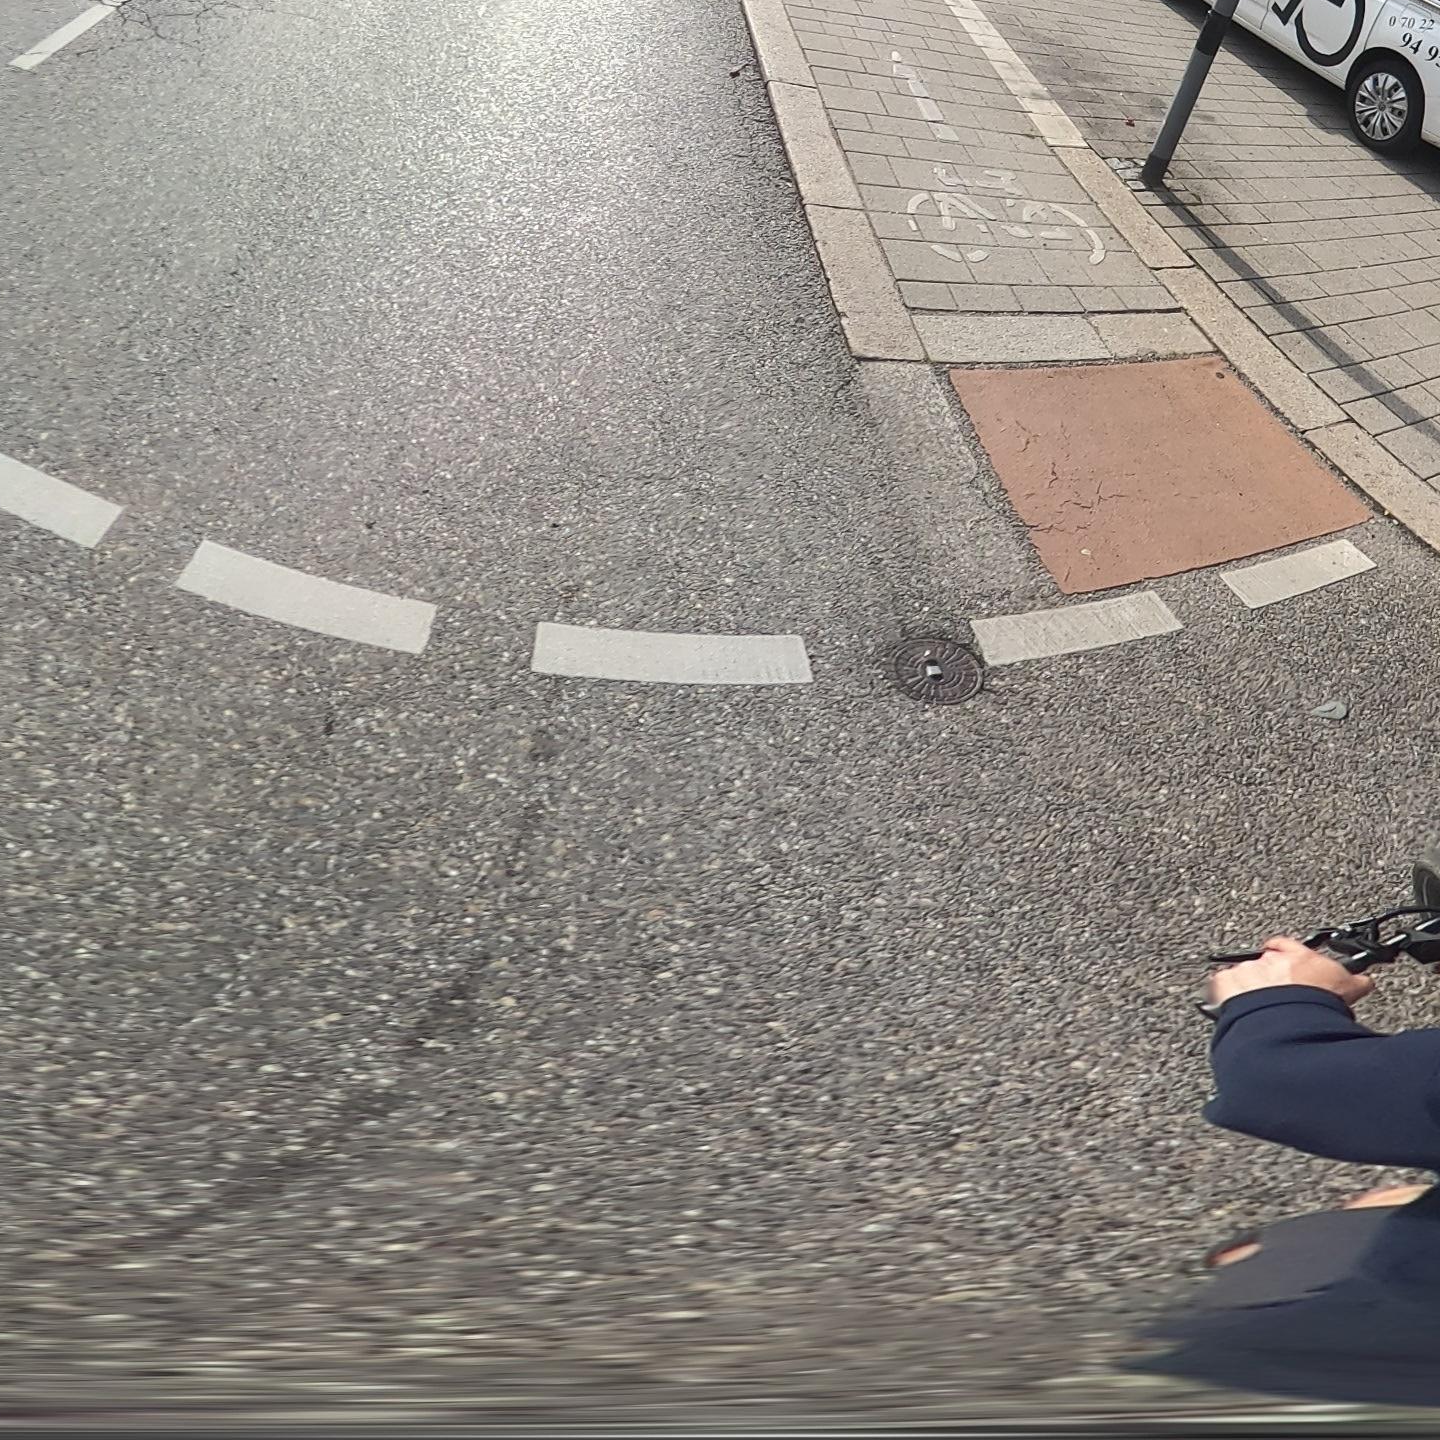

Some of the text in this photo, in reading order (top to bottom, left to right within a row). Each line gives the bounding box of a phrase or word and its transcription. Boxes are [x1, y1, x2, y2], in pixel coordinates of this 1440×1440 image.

[1388, 16, 1435, 31] 0 70 22
[1399, 32, 1422, 55] 94
